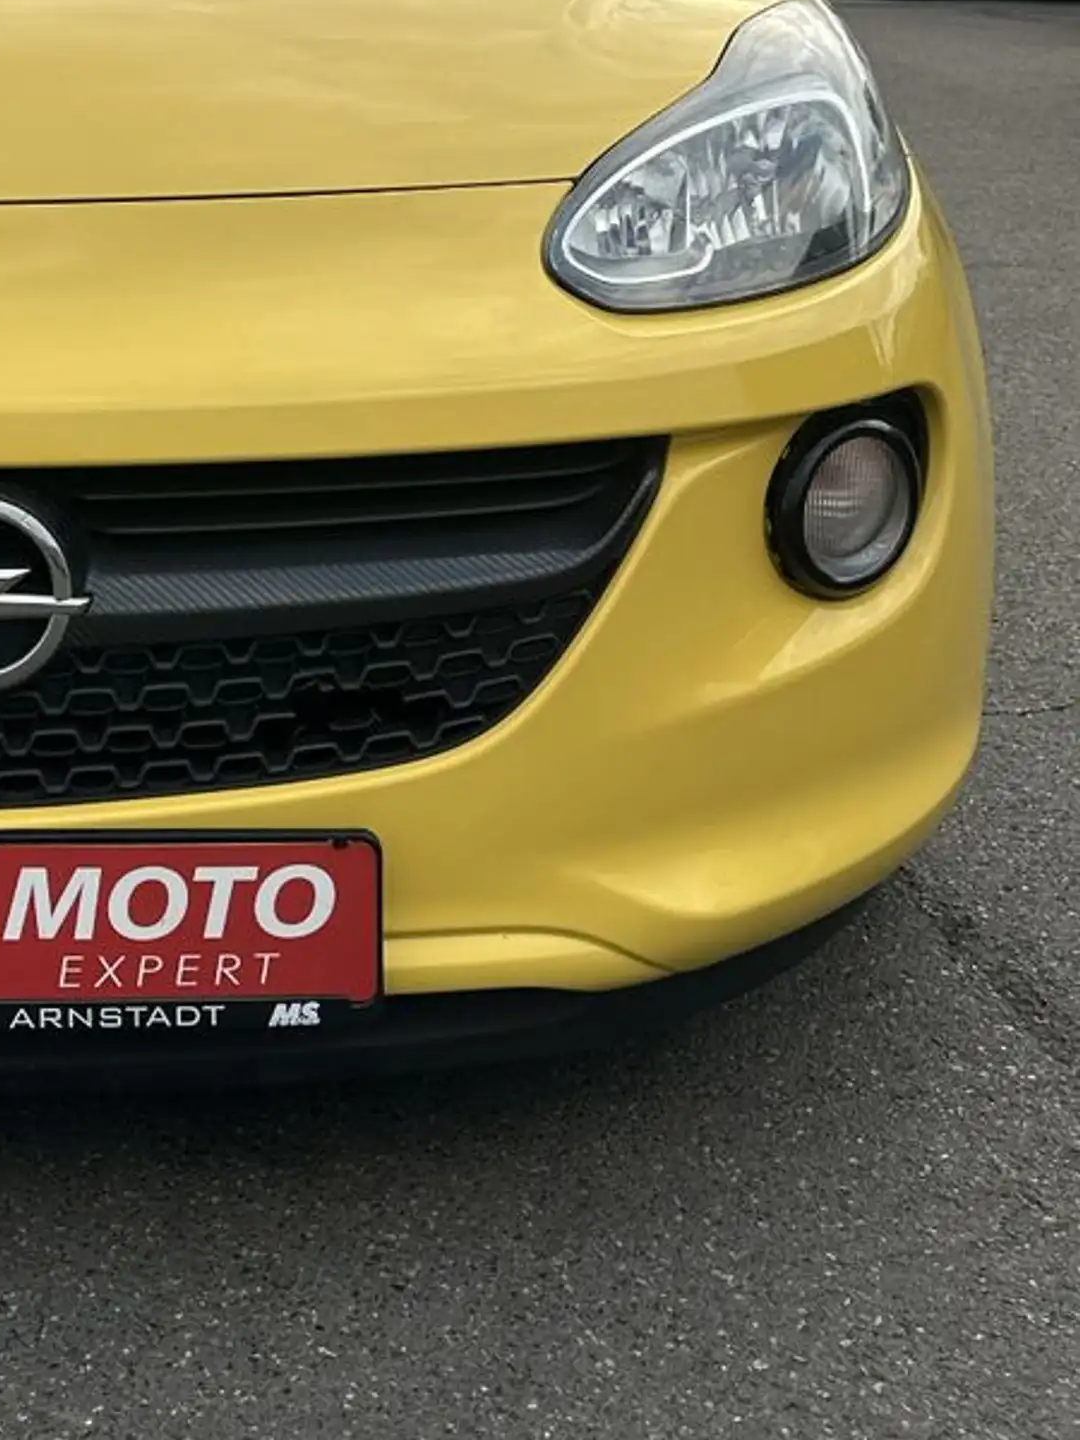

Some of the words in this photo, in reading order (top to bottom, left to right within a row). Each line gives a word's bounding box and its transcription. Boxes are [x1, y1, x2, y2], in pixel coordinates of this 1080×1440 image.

[2, 864, 336, 941] MOTO
[59, 952, 281, 988] EXPERT
[9, 1005, 225, 1029] ARNSTADT
[268, 1002, 321, 1027] MS
